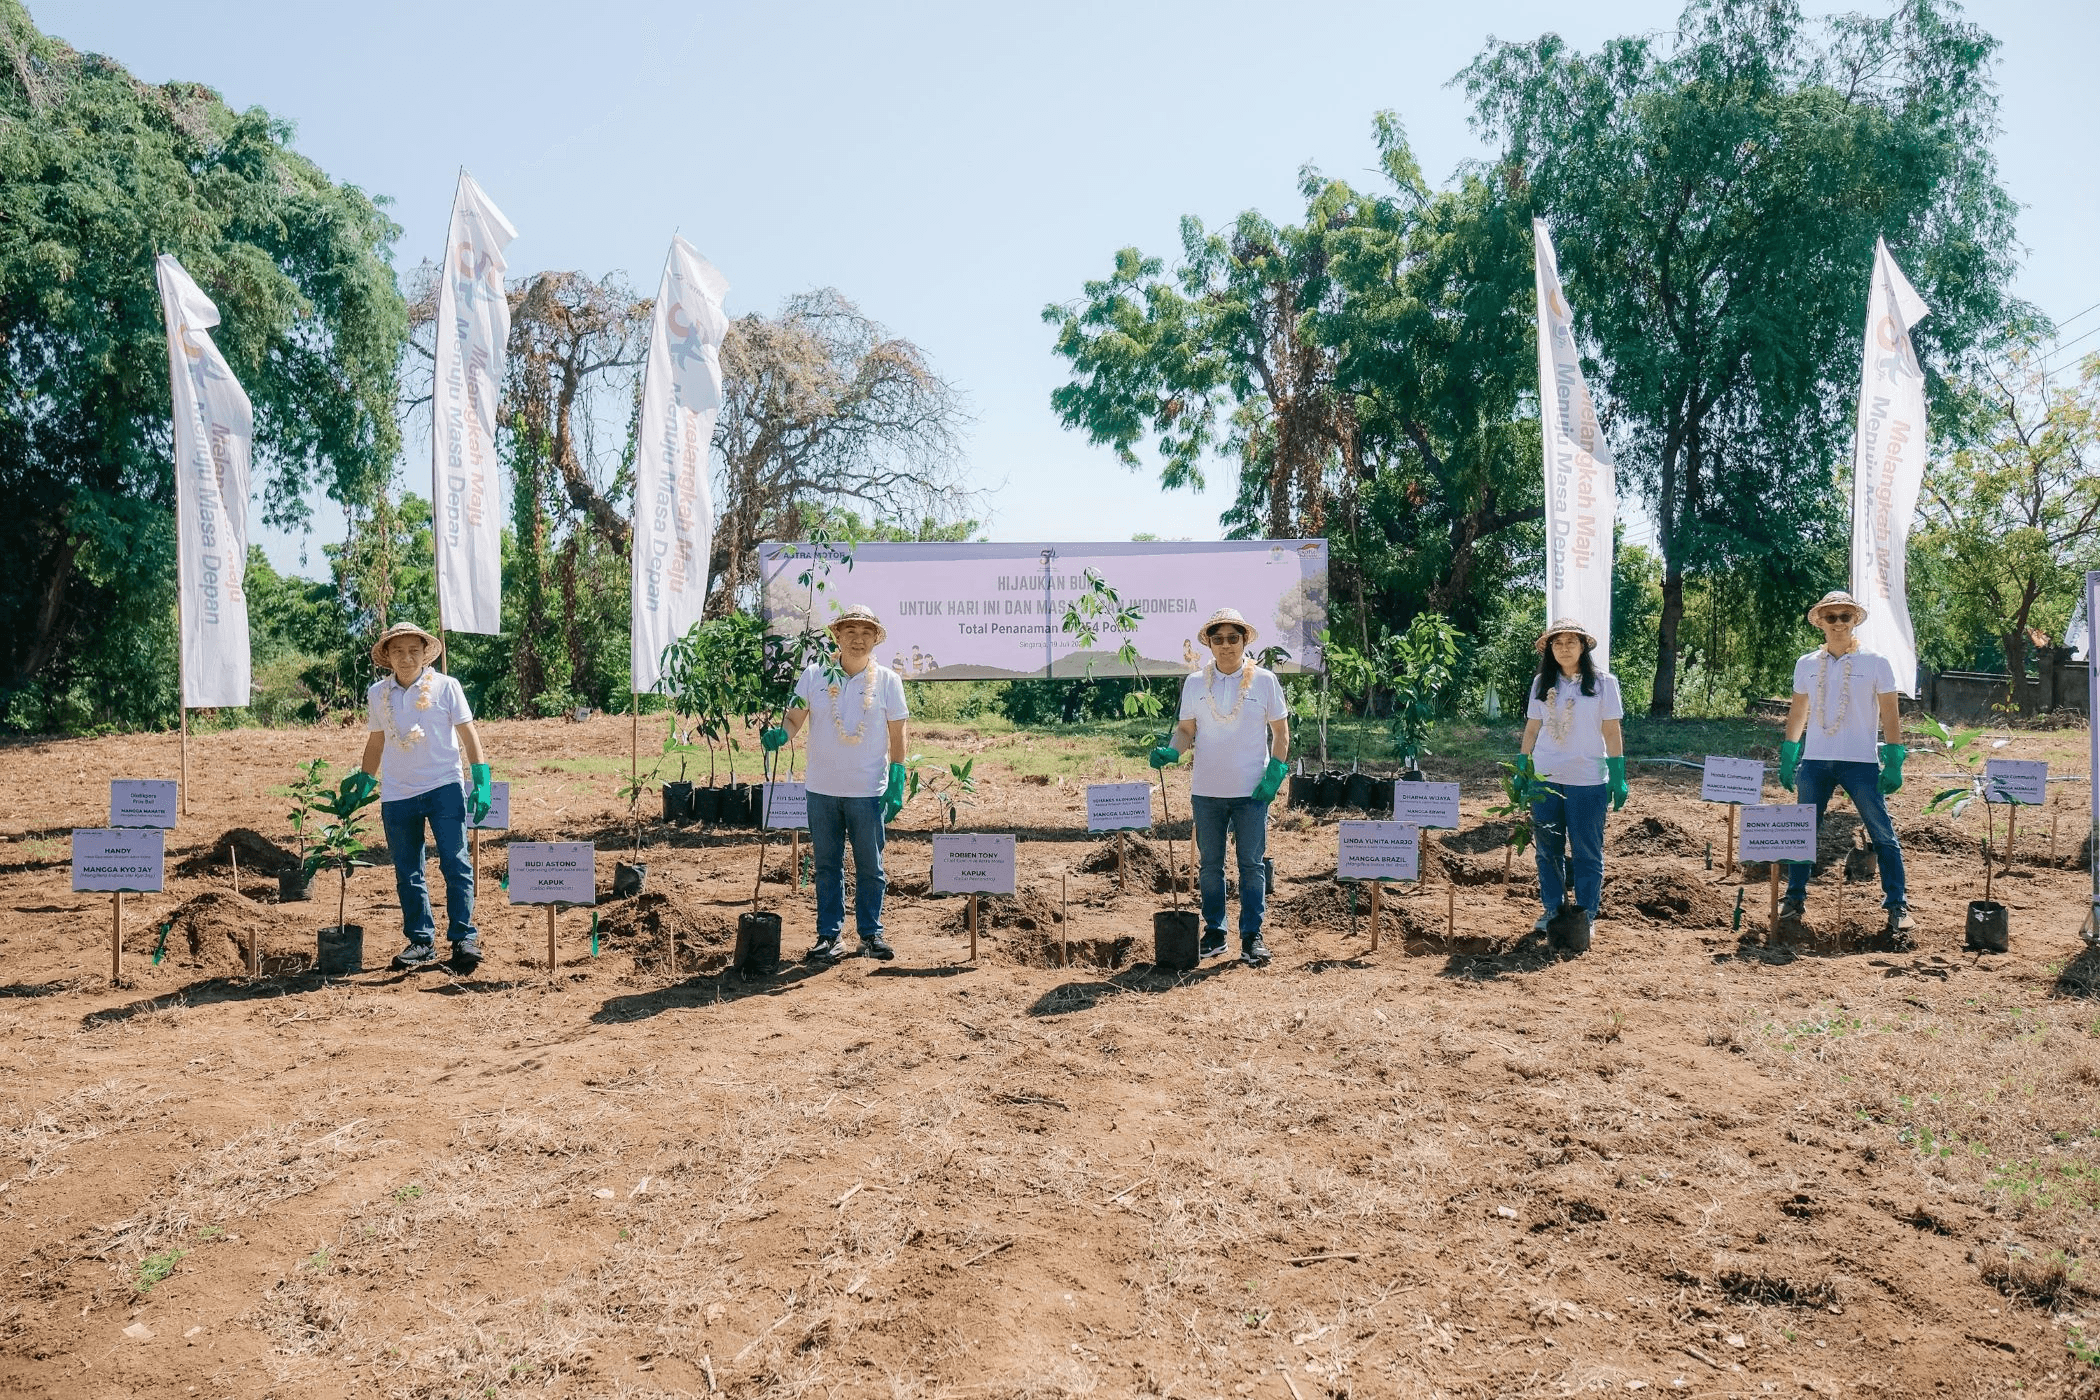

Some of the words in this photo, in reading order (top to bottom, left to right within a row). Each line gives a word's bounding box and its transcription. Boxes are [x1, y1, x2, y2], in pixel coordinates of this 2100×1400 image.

[464, 344, 489, 465] Melangkah
[448, 405, 465, 468] Masa
[467, 472, 486, 528] Maju
[653, 470, 677, 532] Masa
[1555, 451, 1572, 513] Masa
[1876, 419, 1911, 541] Melangkah
[199, 487, 219, 547] Masa
[445, 475, 467, 549] Depan
[1571, 515, 1596, 569] Maju
[198, 554, 222, 624] Depan
[645, 538, 669, 612] Depan
[666, 537, 693, 595] Maju
[997, 575, 1066, 592] HIJAUKAN
[1875, 548, 1892, 600] Maju
[899, 600, 943, 616] UNTUK
[947, 600, 979, 616] HARI
[983, 600, 1001, 616] INI
[1004, 599, 1033, 615] DAN
[958, 623, 988, 635] Total
[991, 622, 1059, 635] Penanaman
